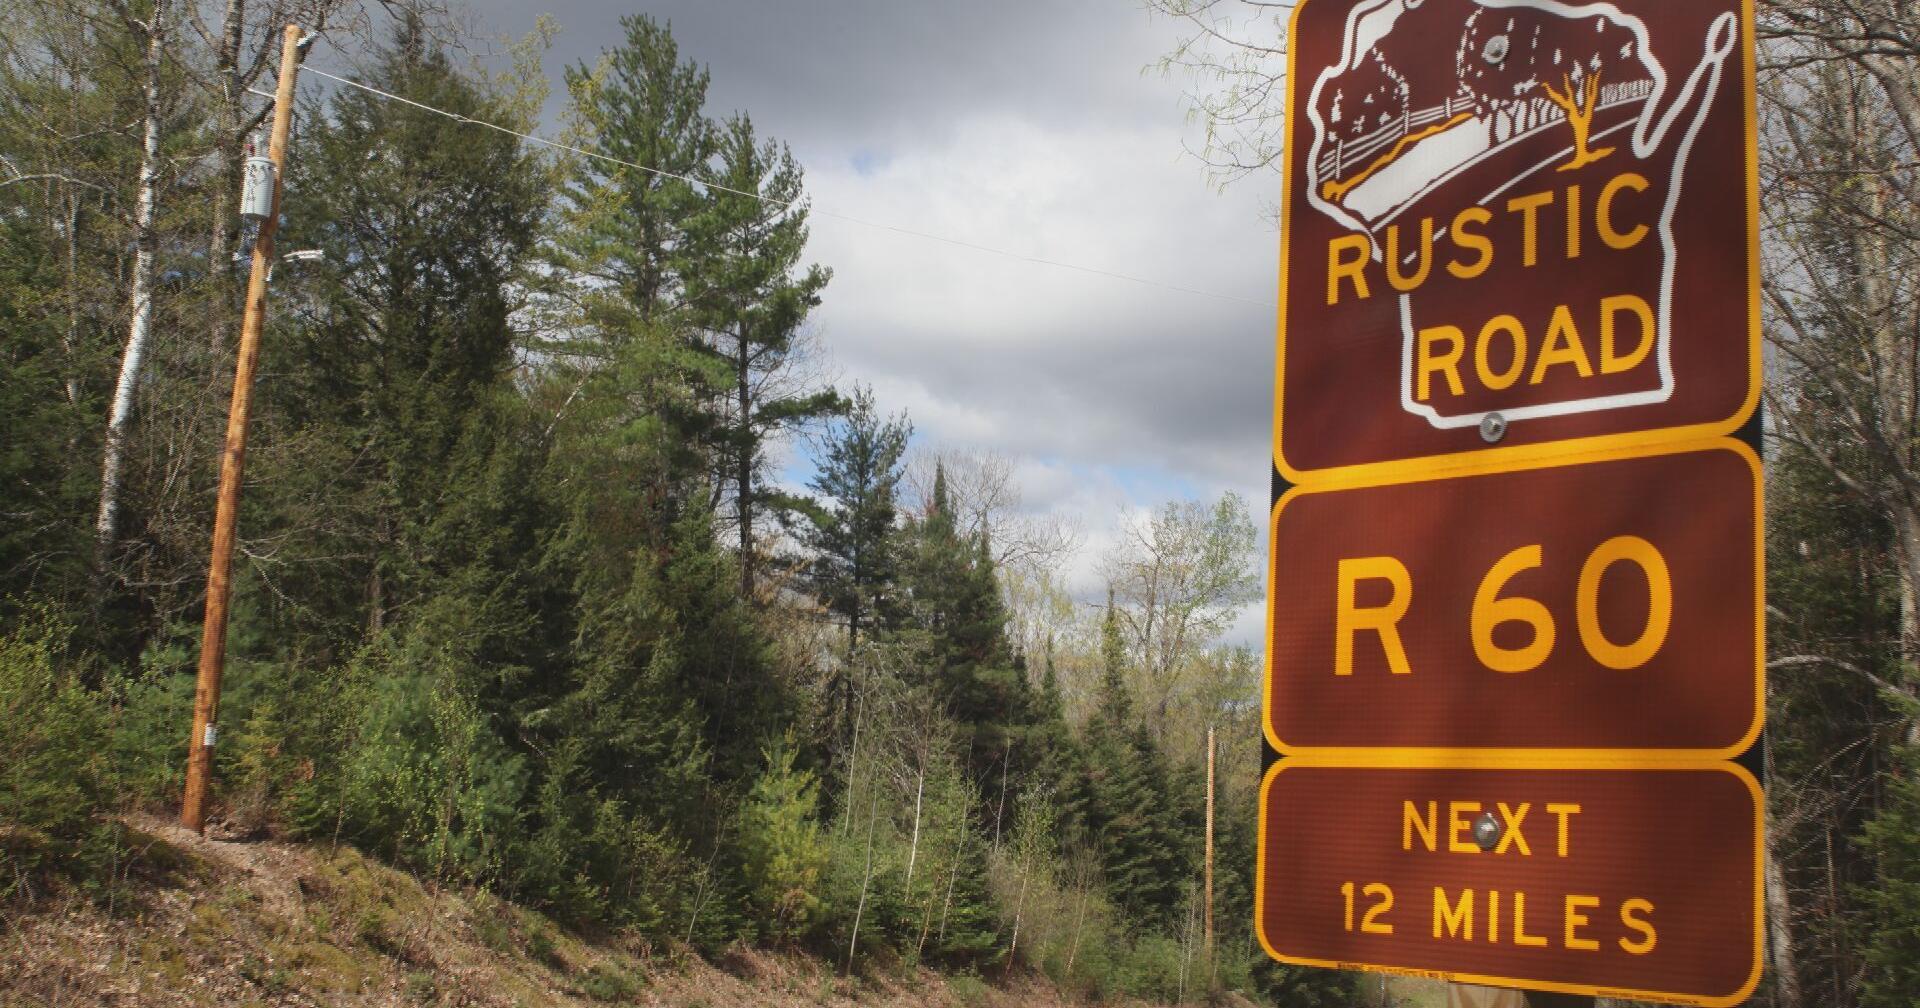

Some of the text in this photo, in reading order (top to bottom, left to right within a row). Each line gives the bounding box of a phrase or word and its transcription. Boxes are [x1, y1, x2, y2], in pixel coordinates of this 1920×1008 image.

[1327, 172, 1651, 306] RUSTIC
[1417, 294, 1656, 401] ROAD
[1335, 535, 1673, 675] R 60
[1402, 800, 1582, 857] NEXT
[1340, 881, 1658, 955] 12 MILES
